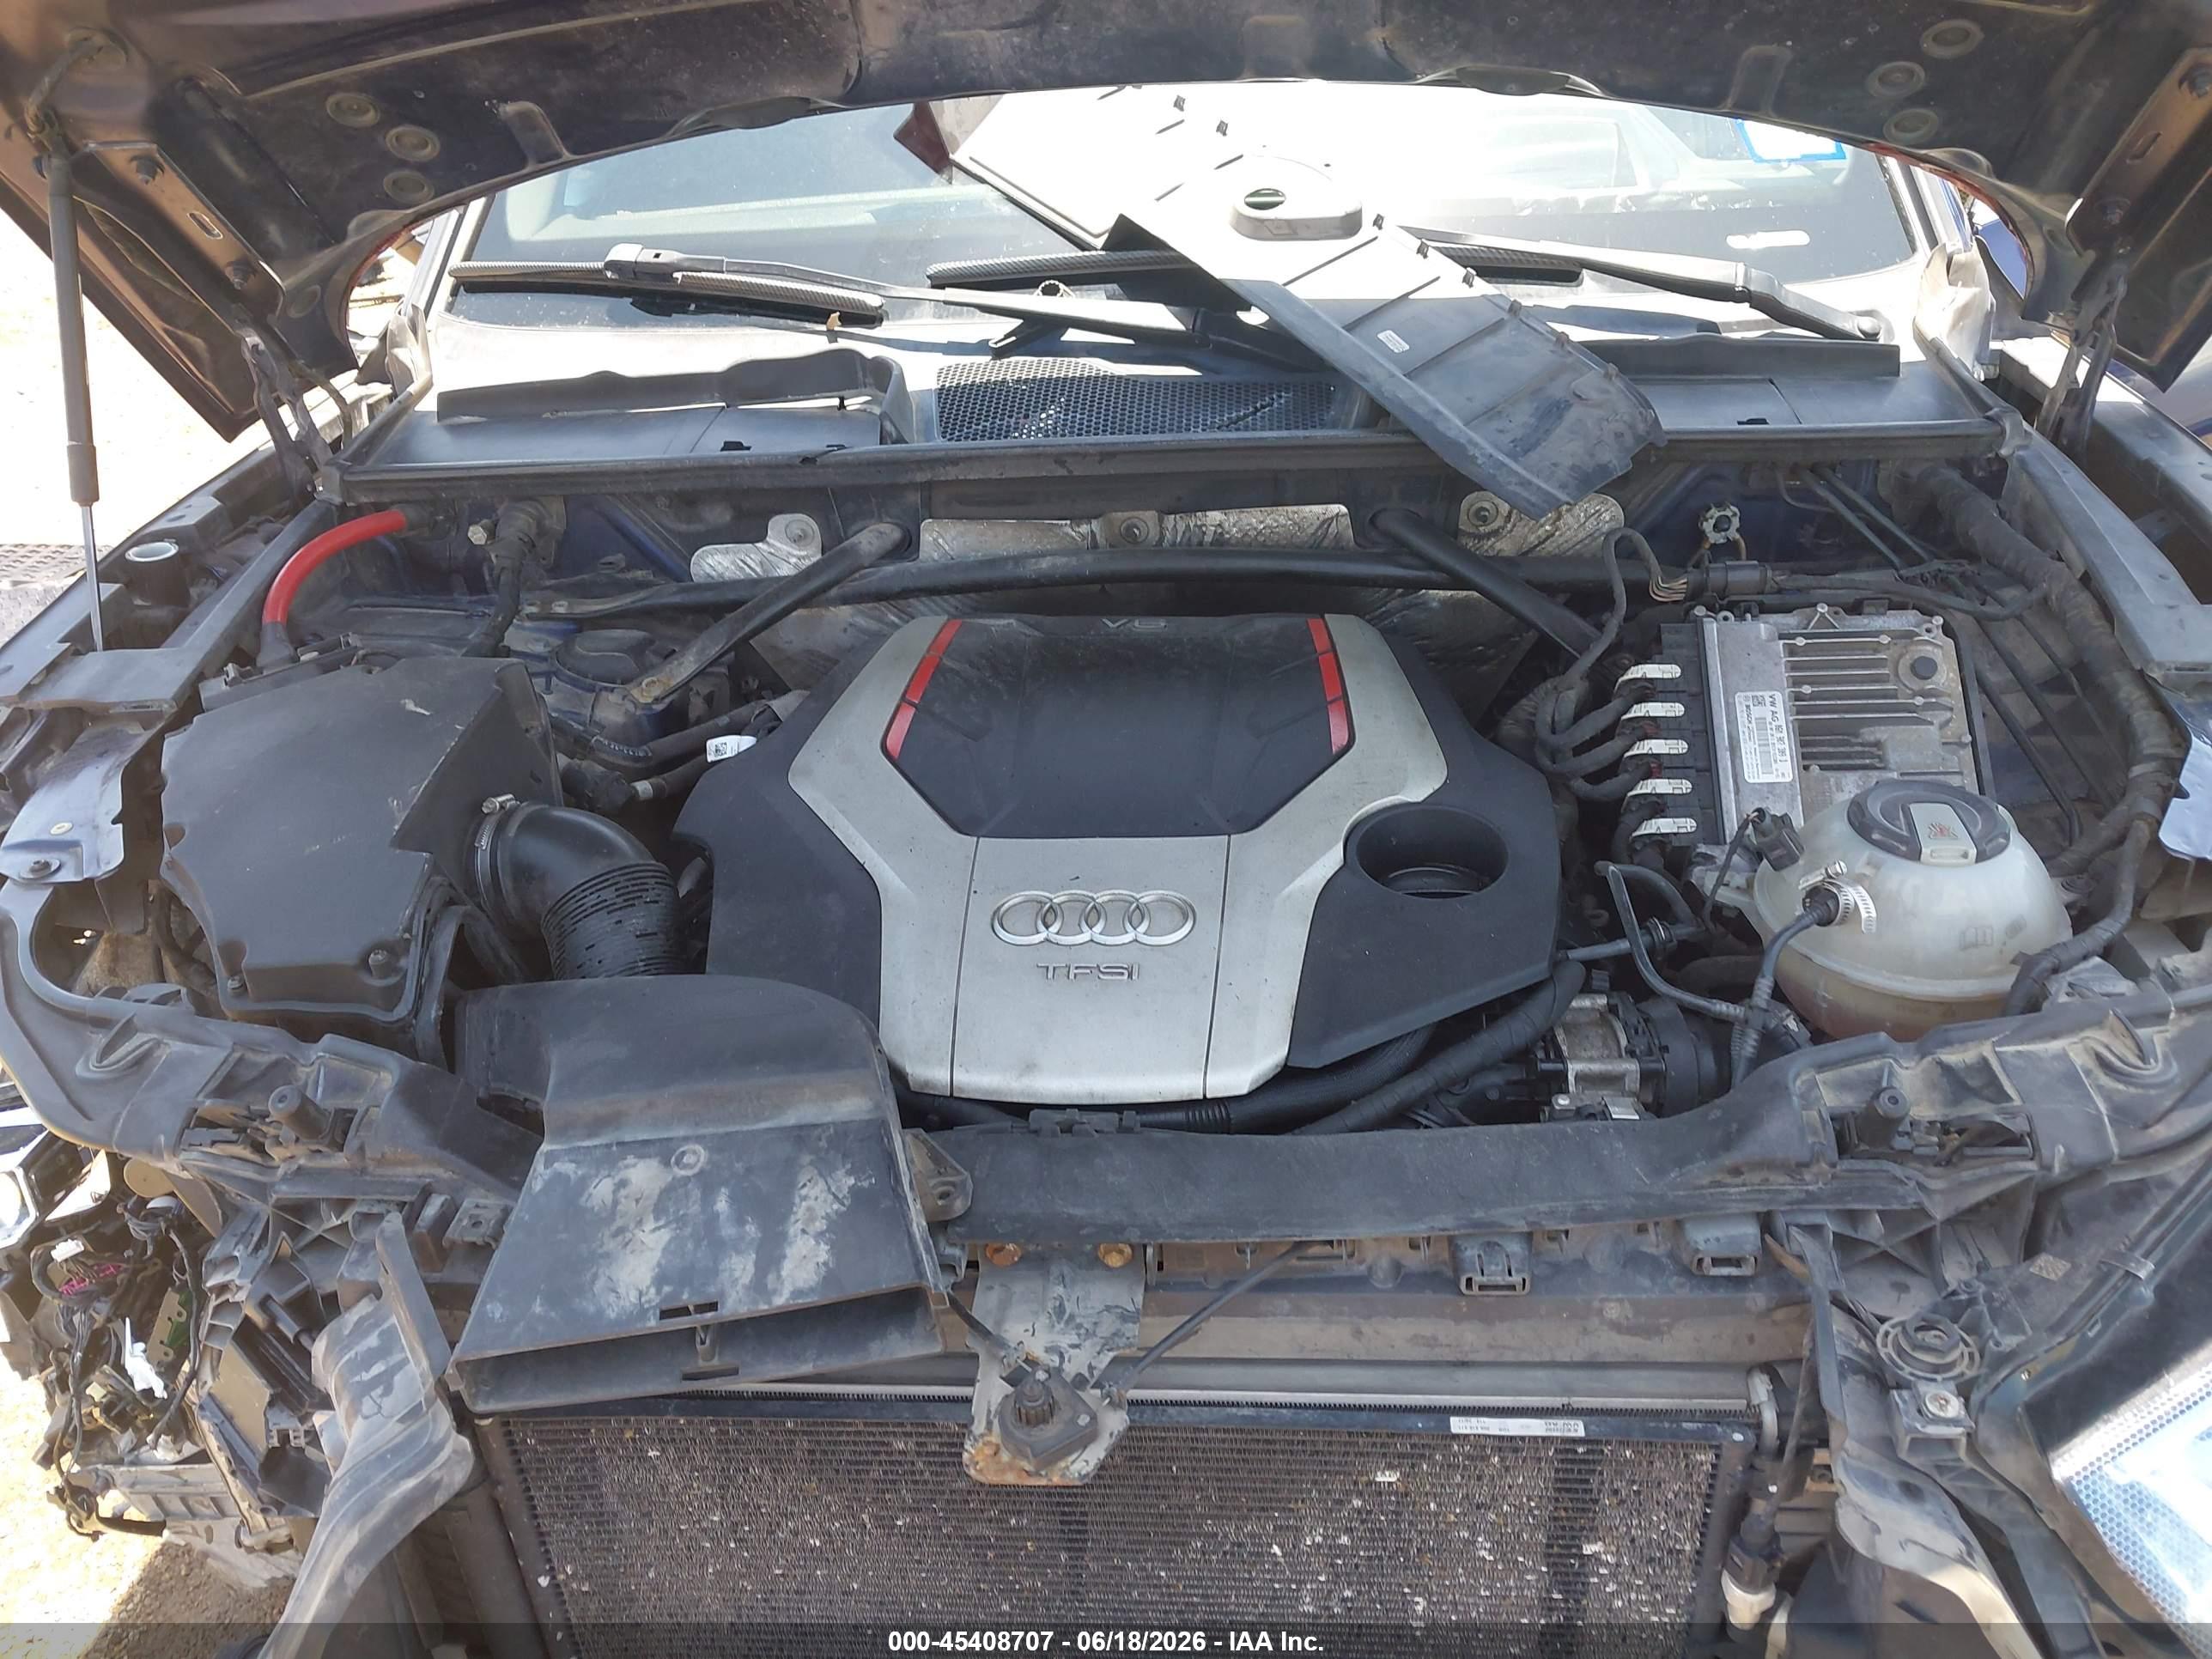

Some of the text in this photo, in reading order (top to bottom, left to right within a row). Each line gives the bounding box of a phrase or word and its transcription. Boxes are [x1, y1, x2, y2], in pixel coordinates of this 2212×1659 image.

[1769, 694, 1778, 708] VW
[1770, 709, 1779, 723] AG
[1036, 963, 1139, 980] TFSI
